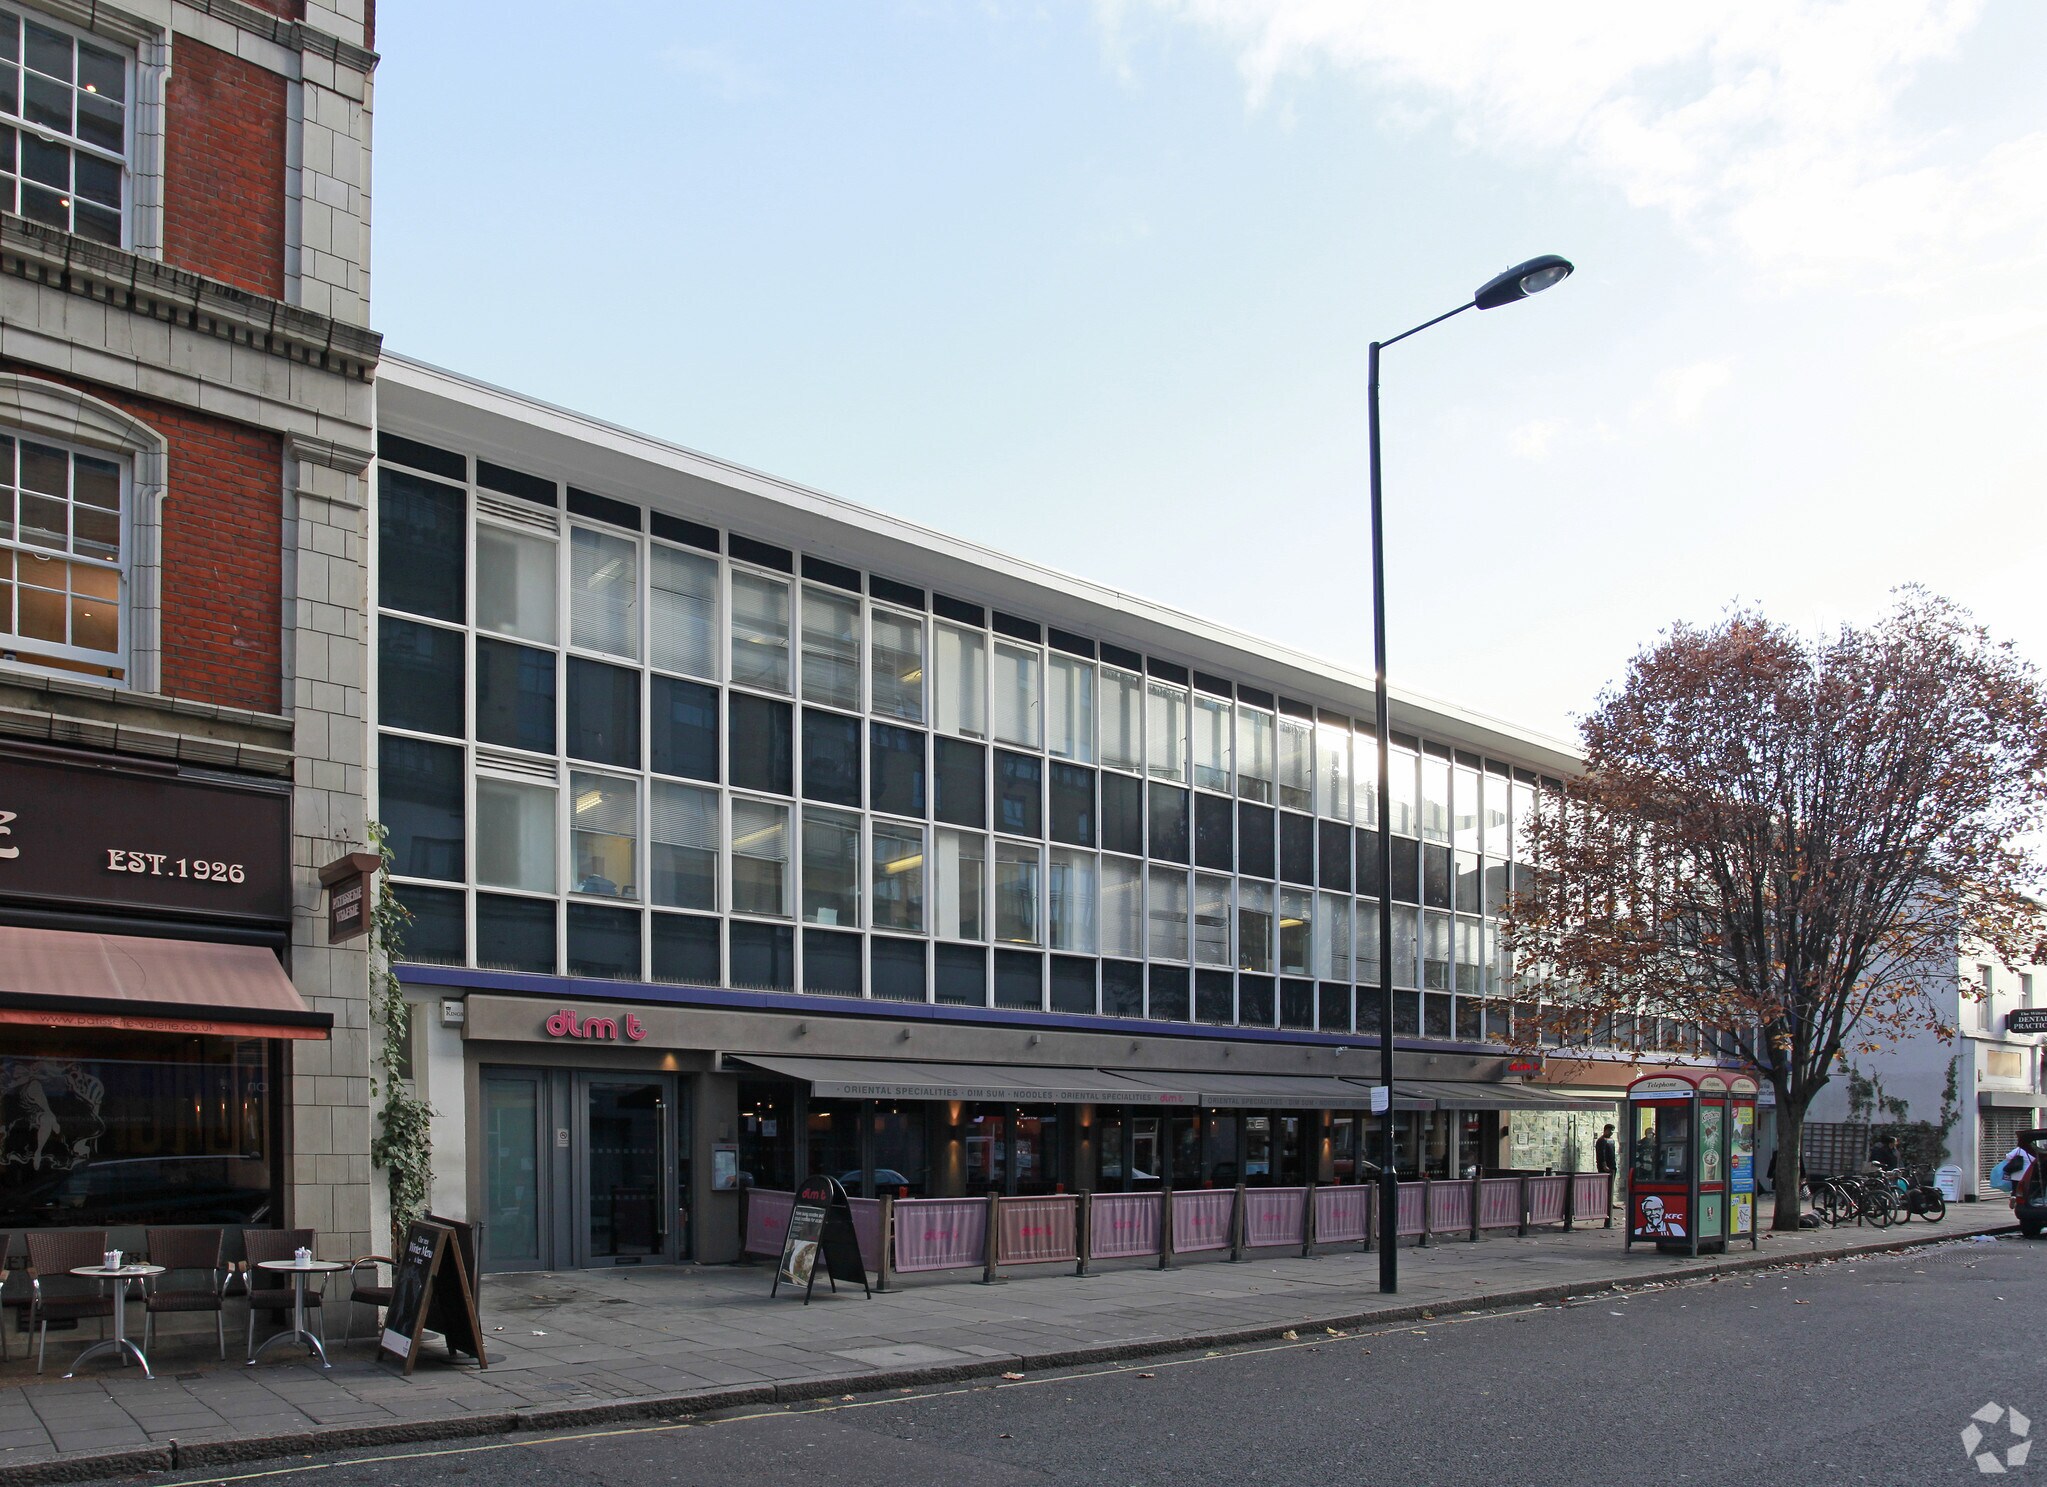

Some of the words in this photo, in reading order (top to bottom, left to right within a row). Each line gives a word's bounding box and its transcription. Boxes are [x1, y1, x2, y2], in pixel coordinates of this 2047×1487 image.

[1647, 1081, 1677, 1089] Telephone
[844, 1085, 892, 1095] ORIENTAL
[895, 1087, 958, 1097] SPECIALITIES
[967, 1089, 984, 1097] DIM
[986, 1090, 1005, 1098] SUM
[1013, 1091, 1053, 1099] NOODLES
[1060, 1091, 1100, 1100] ORIENTAL
[1102, 1092, 1151, 1101] SPECIALITIES
[1207, 1096, 1240, 1105] ORIENTAL
